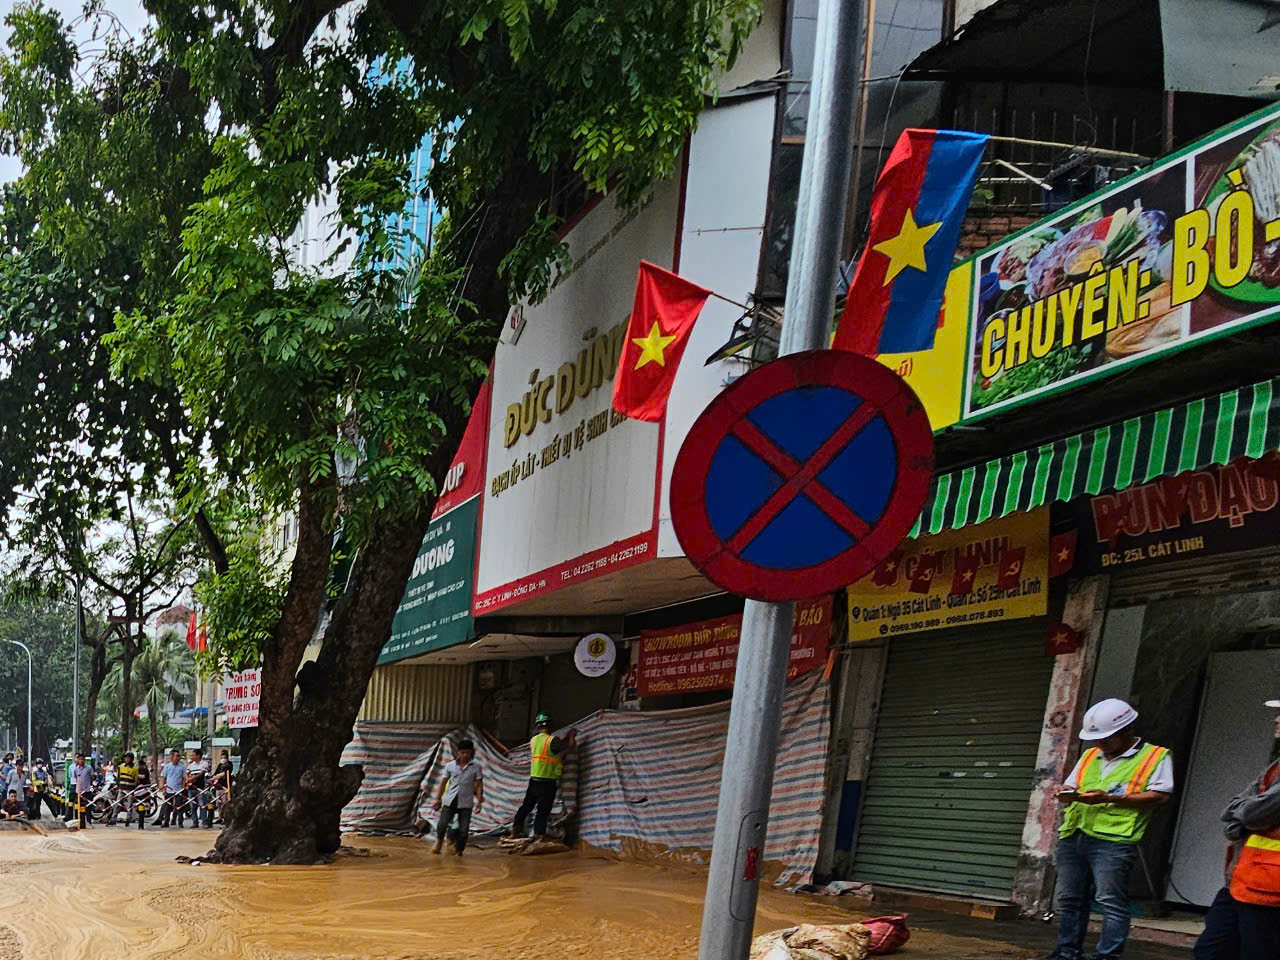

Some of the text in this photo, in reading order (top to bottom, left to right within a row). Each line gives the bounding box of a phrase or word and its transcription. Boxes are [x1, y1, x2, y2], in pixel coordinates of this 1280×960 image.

[980, 167, 1254, 378] CHUYÊN: BÒ
[504, 369, 554, 449] ĐỨC
[491, 409, 608, 498] GẠCH ỐP LÁT THIẾT BỊ VỆ SINH
[573, 566, 581, 577] 04
[581, 561, 595, 574] 2262
[610, 553, 618, 564] 04
[618, 549, 634, 561] 2262
[634, 542, 648, 556] 1199
[1124, 548, 1145, 563] 25L
[1175, 536, 1205, 553] LINH
[863, 607, 881, 621] Quán
[902, 601, 911, 615] 35
[912, 598, 925, 613] Cát
[926, 595, 941, 612] Linh
[1022, 576, 1041, 595] Linh
[643, 632, 692, 653] SHOWROOM
[693, 625, 712, 646] ĐỨC
[225, 684, 248, 700] TRUNG
[648, 680, 675, 692] Hotline:
